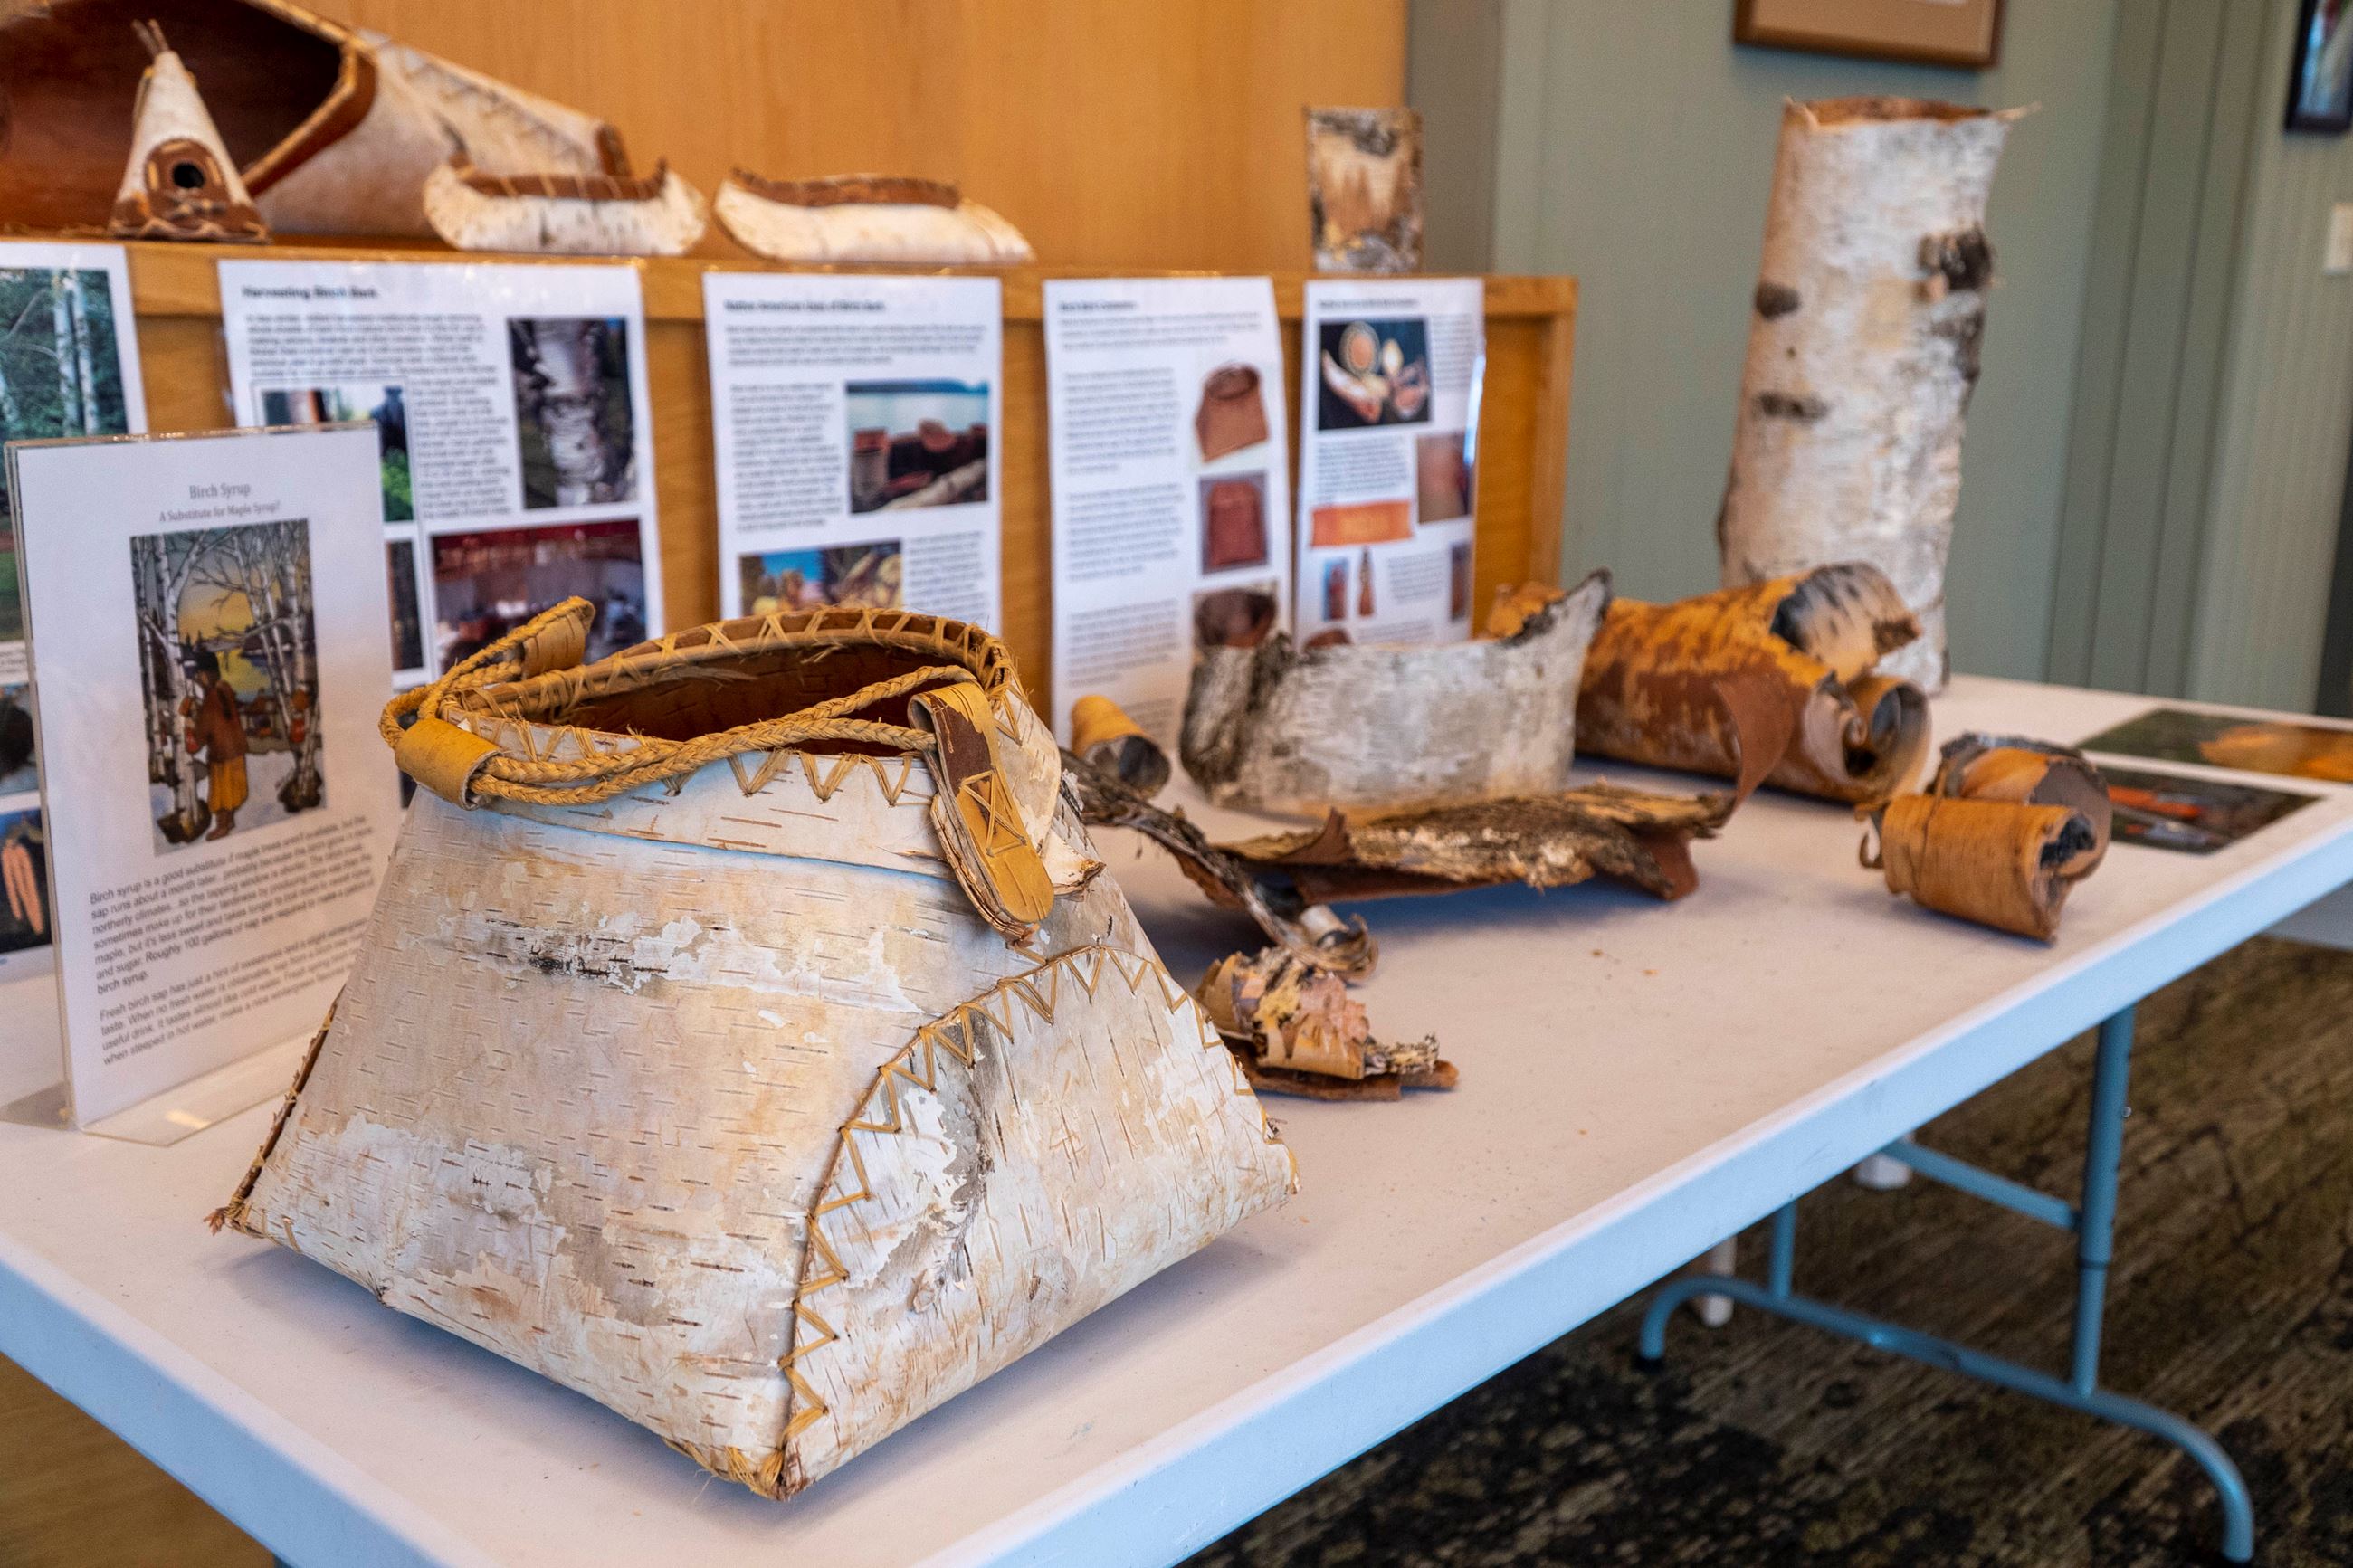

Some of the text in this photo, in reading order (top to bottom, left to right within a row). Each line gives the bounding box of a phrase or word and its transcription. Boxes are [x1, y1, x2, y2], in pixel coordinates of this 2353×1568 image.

[160, 500, 281, 522] A Substitute for Maple Syrup?
[189, 482, 251, 499] Birch Syrup
[90, 889, 113, 905] Birch
[116, 882, 141, 898] syrup
[143, 879, 151, 889] is
[153, 877, 159, 885] a
[161, 868, 183, 885] good
[185, 857, 225, 876] substitute
[234, 847, 260, 860] maple
[90, 908, 108, 919] sap
[110, 901, 130, 914] runs
[133, 890, 158, 907] about
[160, 890, 166, 898] a
[168, 879, 195, 896] month
[223, 862, 257, 881] probably
[92, 915, 132, 935] northerly
[178, 898, 188, 908] so
[190, 893, 205, 904] the
[205, 883, 238, 898] tapping
[239, 873, 269, 889] window
[93, 927, 143, 950] sometimes
[145, 918, 169, 934] make
[171, 915, 182, 925] up
[185, 910, 195, 920] for
[198, 903, 216, 917] their
[94, 949, 124, 965] maple,
[128, 941, 141, 955] but
[144, 938, 157, 949] it's
[158, 932, 176, 944] less
[178, 921, 203, 937] sweet
[205, 915, 222, 928] and
[224, 909, 246, 922] takes
[95, 966, 113, 981] and
[115, 959, 142, 974] sugar.
[145, 945, 181, 964] Roughly
[184, 937, 199, 951] 100
[202, 928, 232, 946] gallons
[233, 923, 243, 934] of
[244, 919, 259, 930] sap
[97, 972, 148, 995] birch syrup.
[100, 1003, 125, 1021] Fresh
[128, 994, 149, 1011] birch
[151, 990, 167, 1002] sap
[169, 984, 185, 995] has
[187, 975, 203, 991] just
[205, 974, 210, 983] a
[213, 966, 228, 980] hint
[230, 962, 239, 974] of
[100, 1021, 124, 1035] taste.
[128, 1010, 154, 1025] When
[156, 1004, 167, 1015] no
[169, 993, 191, 1011] fresh
[193, 987, 215, 1002] water
[218, 983, 224, 993] is
[102, 1031, 129, 1050] useful
[130, 1023, 153, 1040] drink.
[157, 1019, 164, 1030] It
[166, 1011, 190, 1026] tastes
[193, 997, 221, 1016] almost
[224, 993, 238, 1004] like
[103, 1050, 128, 1066] when
[130, 1033, 164, 1055] steeped
[167, 1031, 174, 1041] in
[176, 1024, 190, 1038] hot
